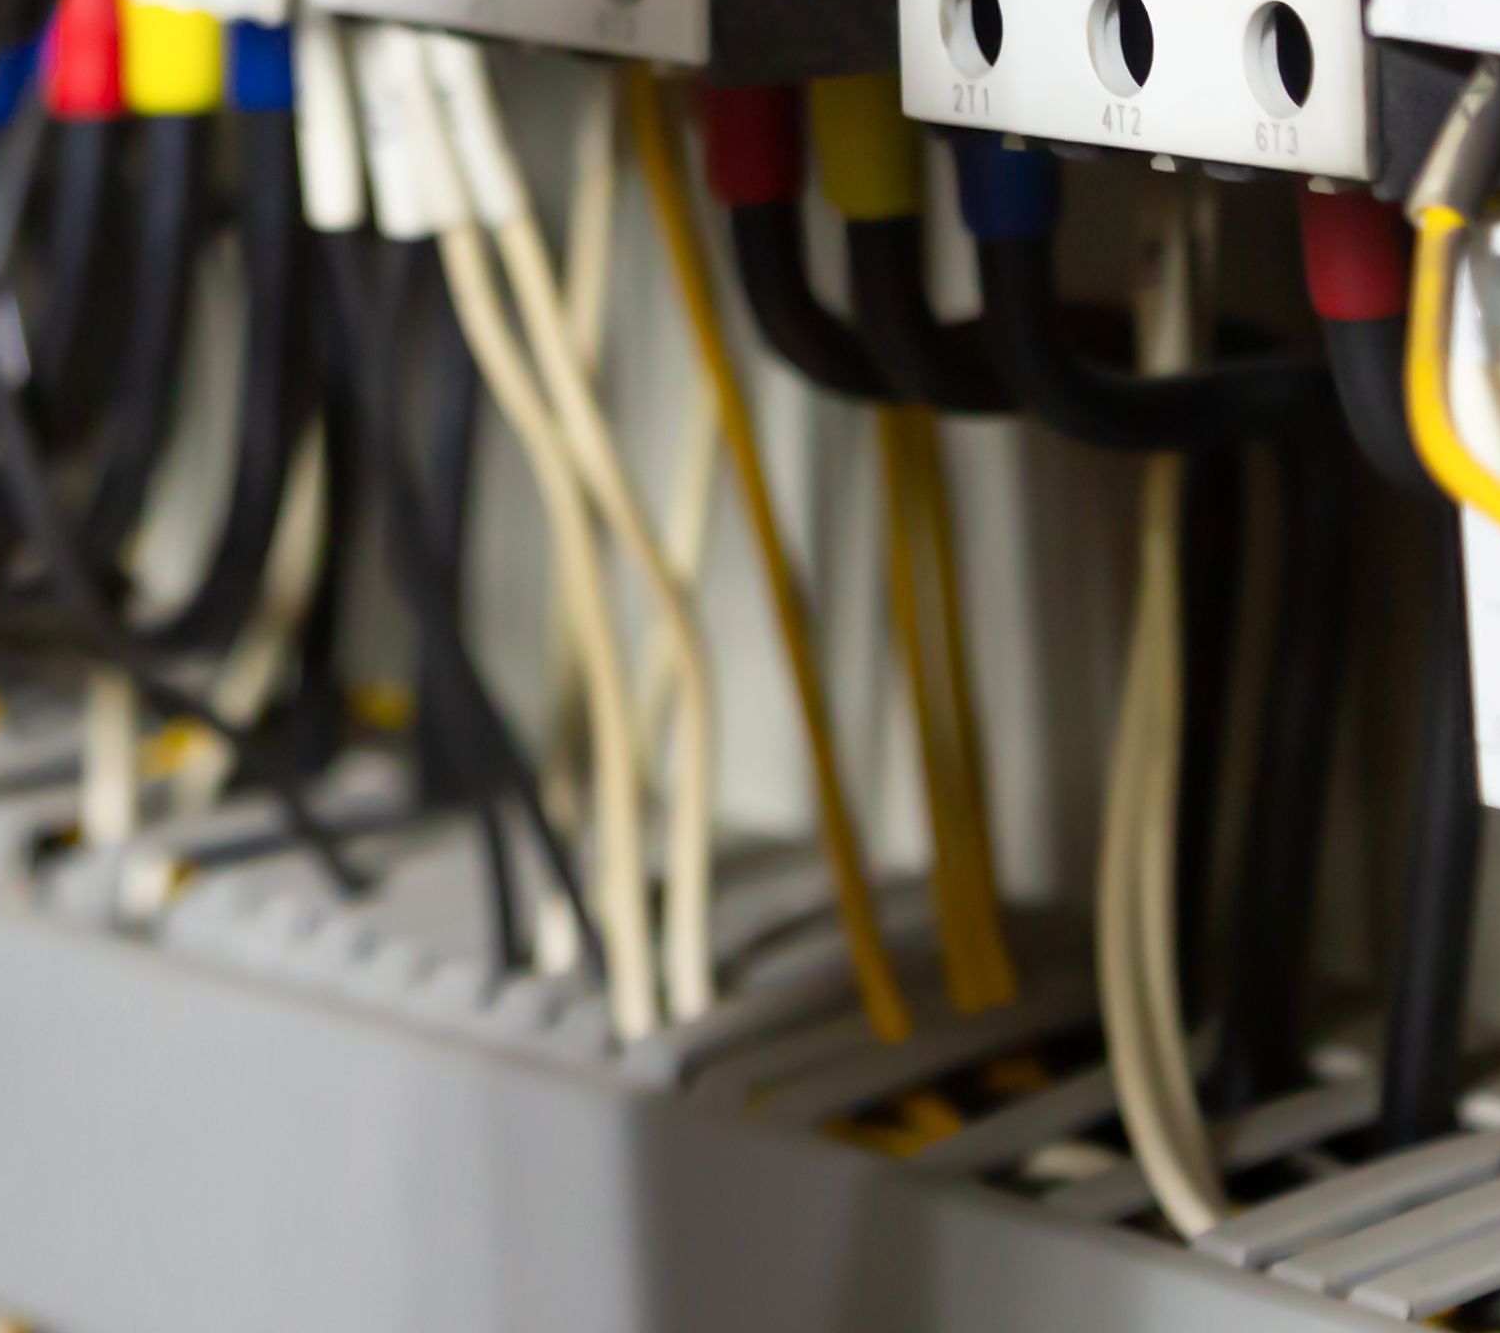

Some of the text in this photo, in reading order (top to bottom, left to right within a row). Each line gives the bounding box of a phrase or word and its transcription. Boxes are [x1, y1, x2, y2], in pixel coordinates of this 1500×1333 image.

[952, 84, 1299, 156] 2T1 4T2 6T3
